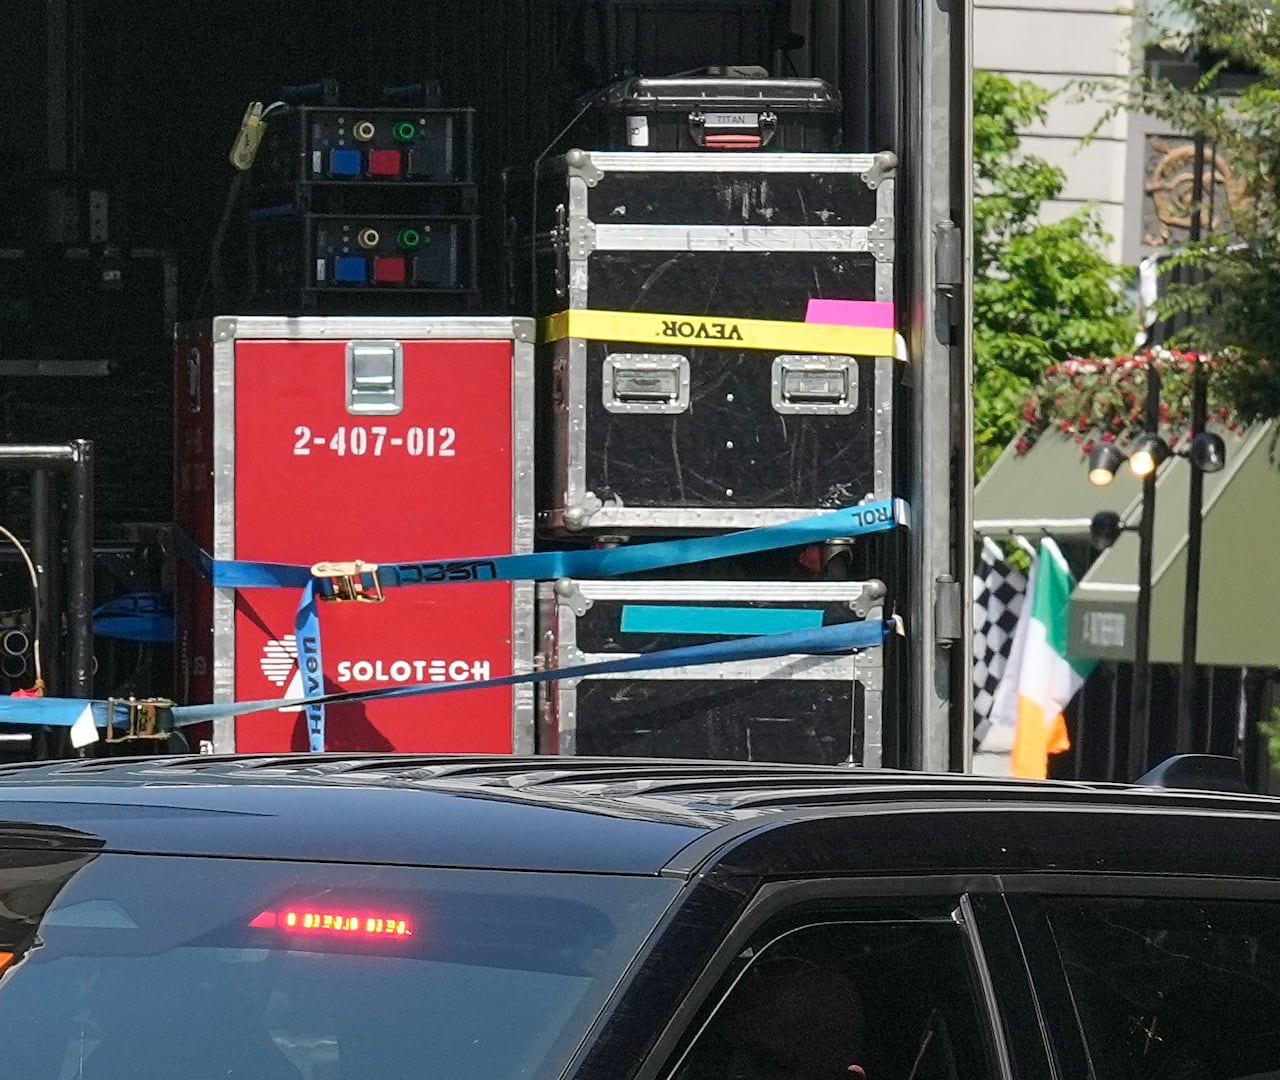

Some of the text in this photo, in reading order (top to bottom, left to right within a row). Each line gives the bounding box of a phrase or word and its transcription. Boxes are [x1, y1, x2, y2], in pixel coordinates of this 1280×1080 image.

[661, 320, 744, 341] VEVOR
[293, 425, 456, 457] 2-407-012
[337, 659, 491, 683] SOLOTECH
